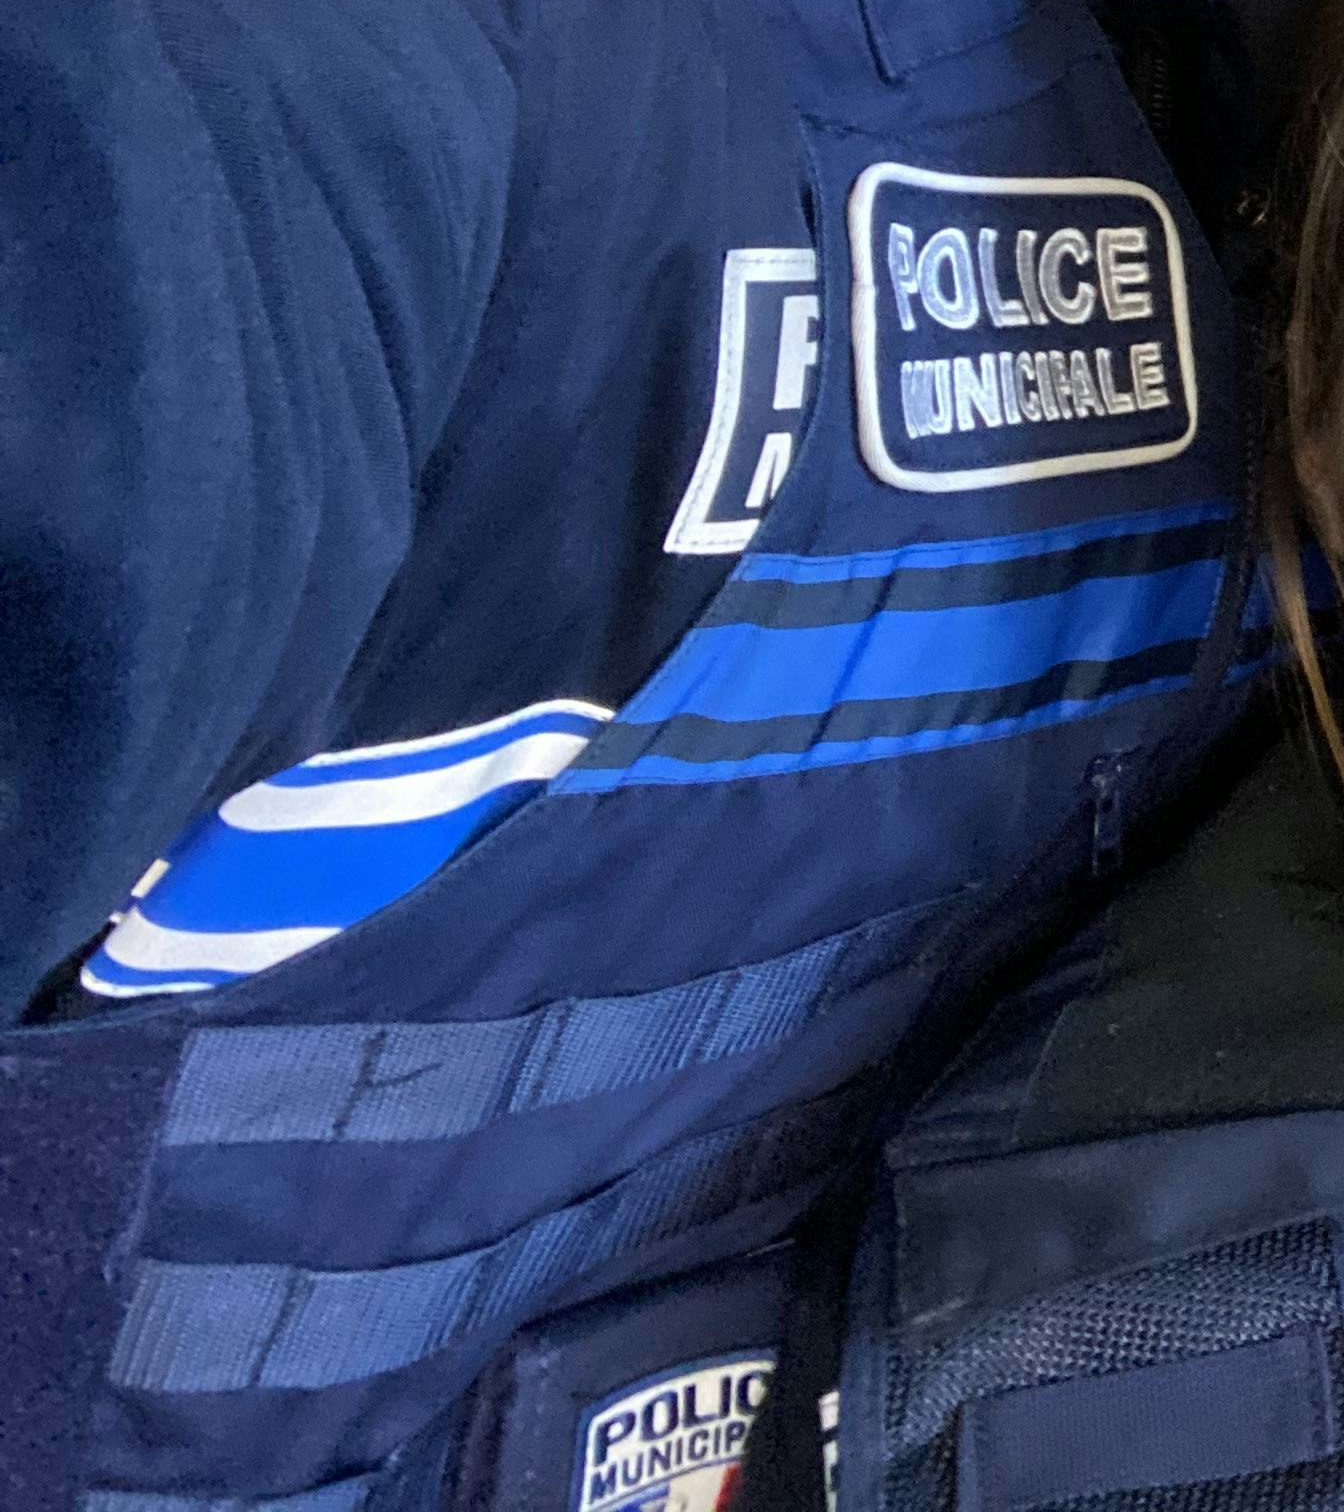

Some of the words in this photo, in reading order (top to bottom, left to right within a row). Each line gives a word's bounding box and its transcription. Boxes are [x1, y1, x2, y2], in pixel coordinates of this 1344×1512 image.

[888, 222, 1153, 330] POLICE
[589, 1420, 746, 1504] MUNICIP
[593, 1370, 767, 1466] POLIC
